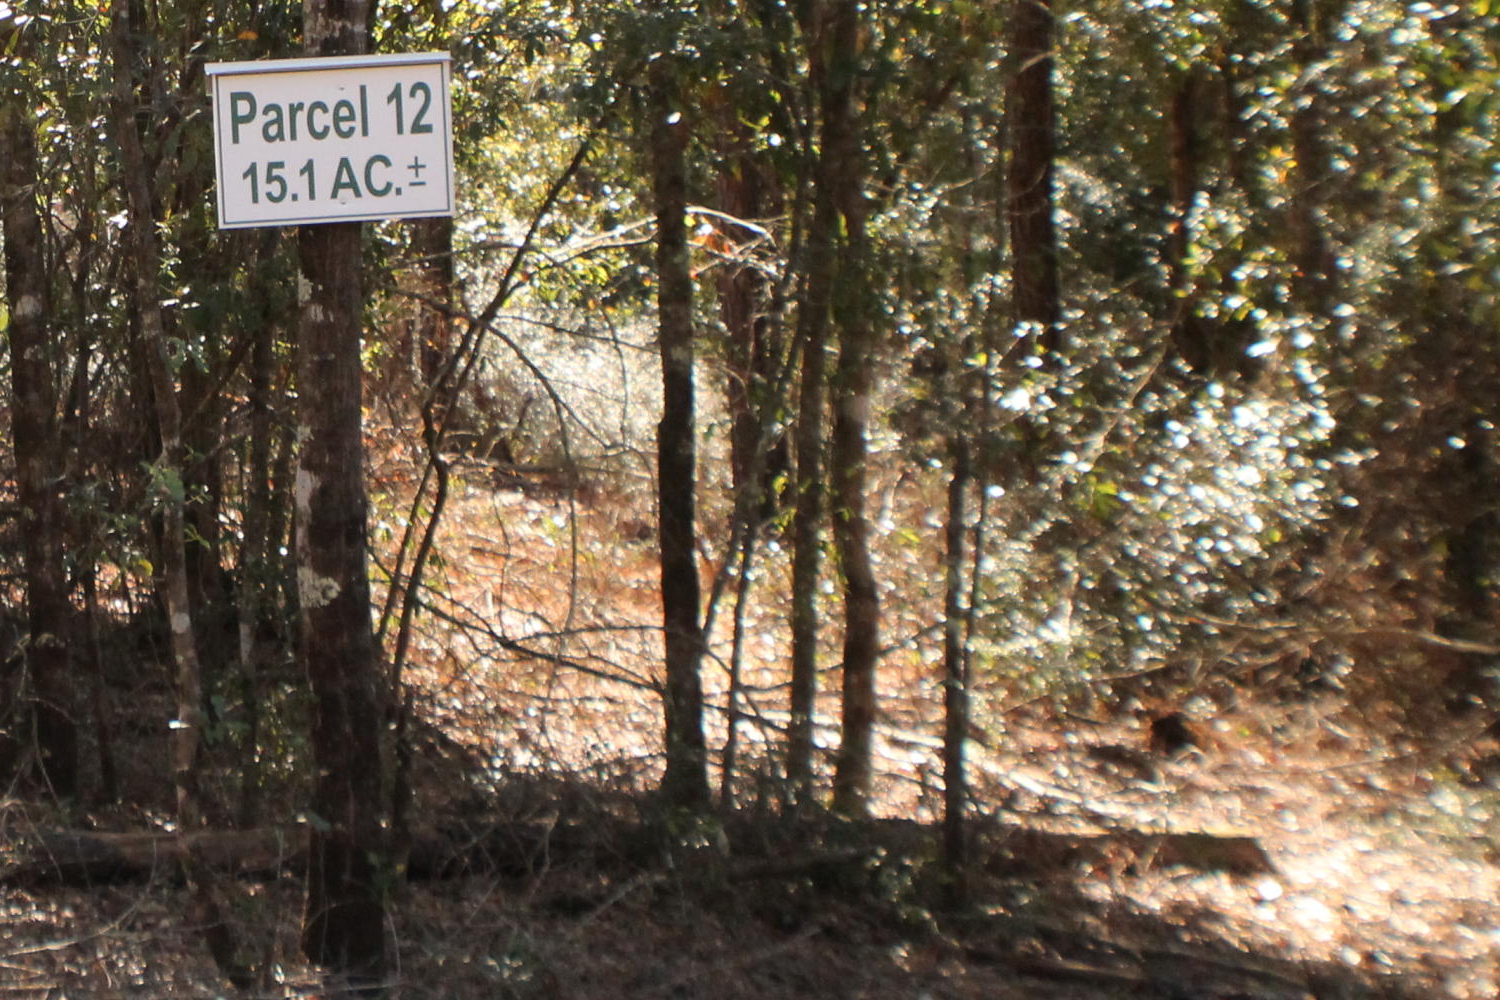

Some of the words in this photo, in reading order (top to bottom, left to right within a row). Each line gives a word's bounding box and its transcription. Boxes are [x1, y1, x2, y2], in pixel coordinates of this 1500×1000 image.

[230, 84, 369, 145] Parcel
[386, 81, 434, 135] 12
[242, 158, 316, 204] 15.1
